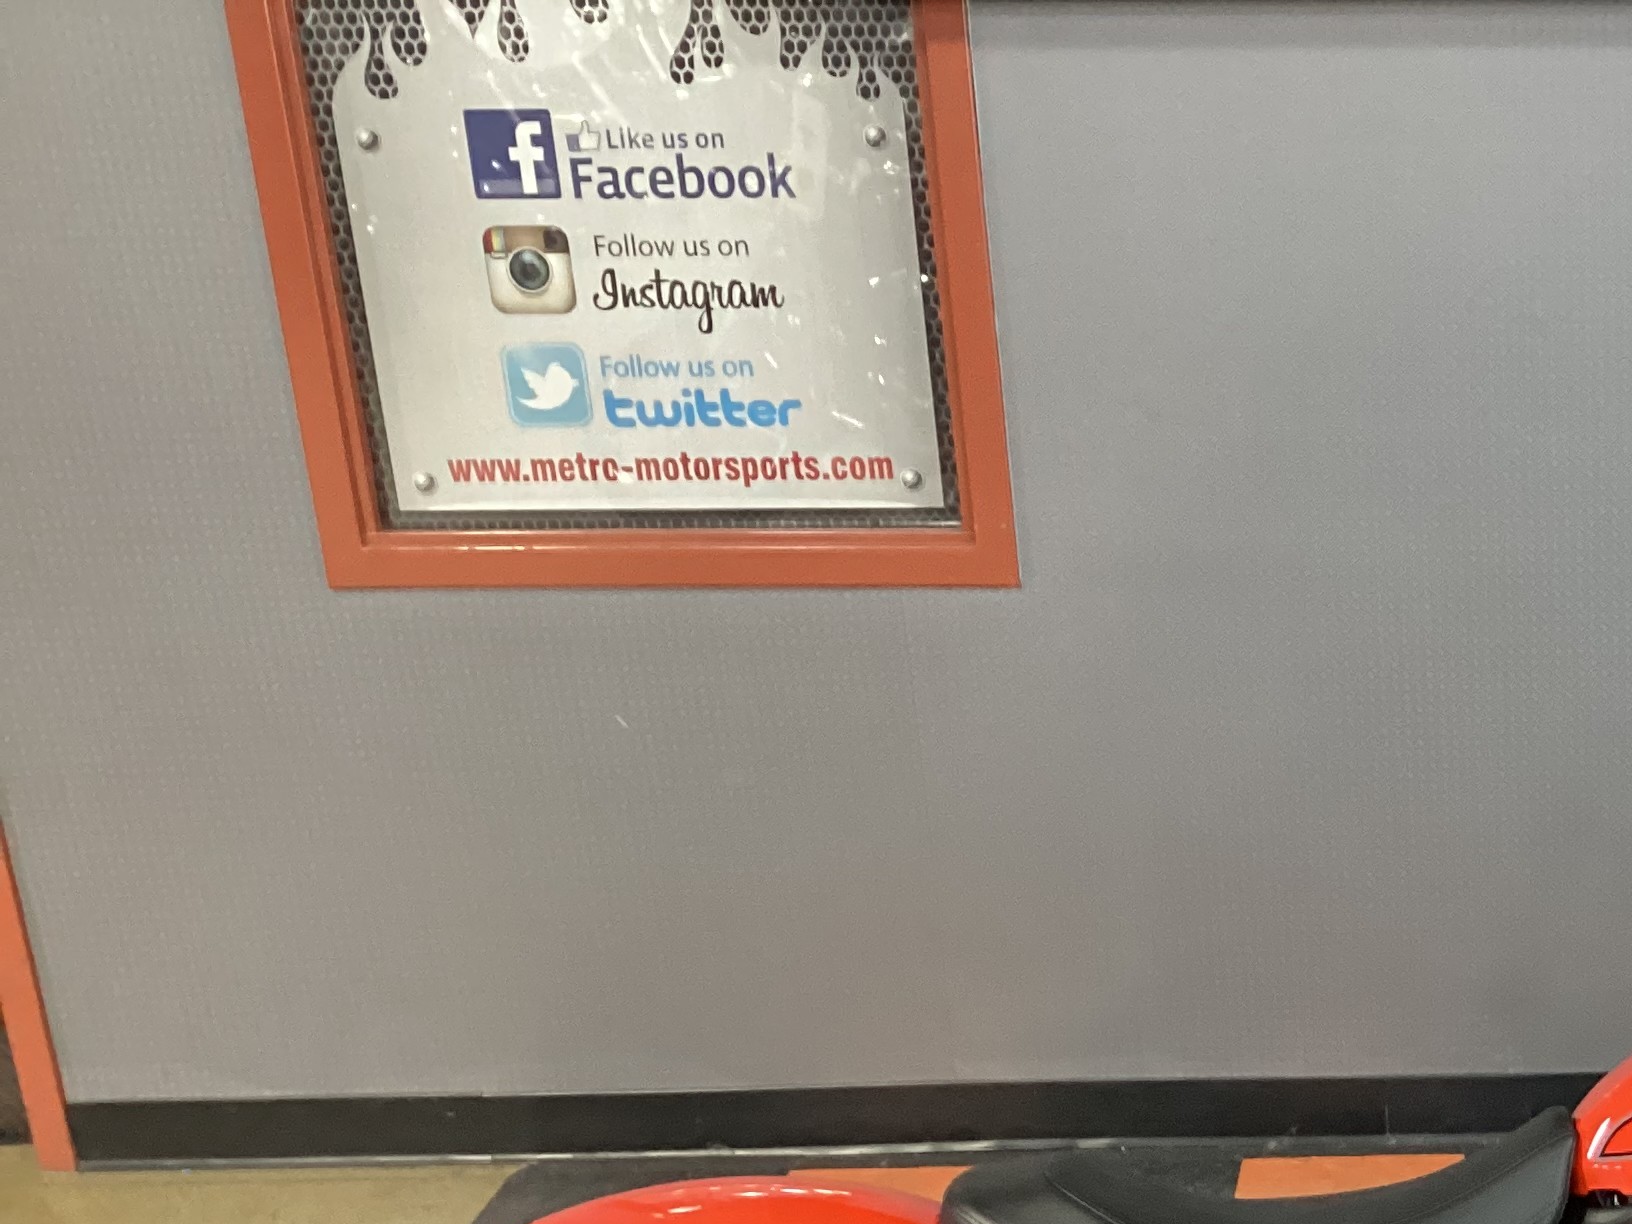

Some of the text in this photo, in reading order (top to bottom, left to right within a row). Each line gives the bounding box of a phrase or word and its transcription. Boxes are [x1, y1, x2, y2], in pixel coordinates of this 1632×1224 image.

[606, 128, 724, 149] Like us on
[571, 153, 797, 199] Facebook
[594, 234, 749, 256] Follow us on
[593, 268, 784, 334] Instagram
[600, 355, 754, 378] Follow us on
[603, 388, 802, 428] twitter
[448, 451, 894, 487] www.metro-motorsports.com
